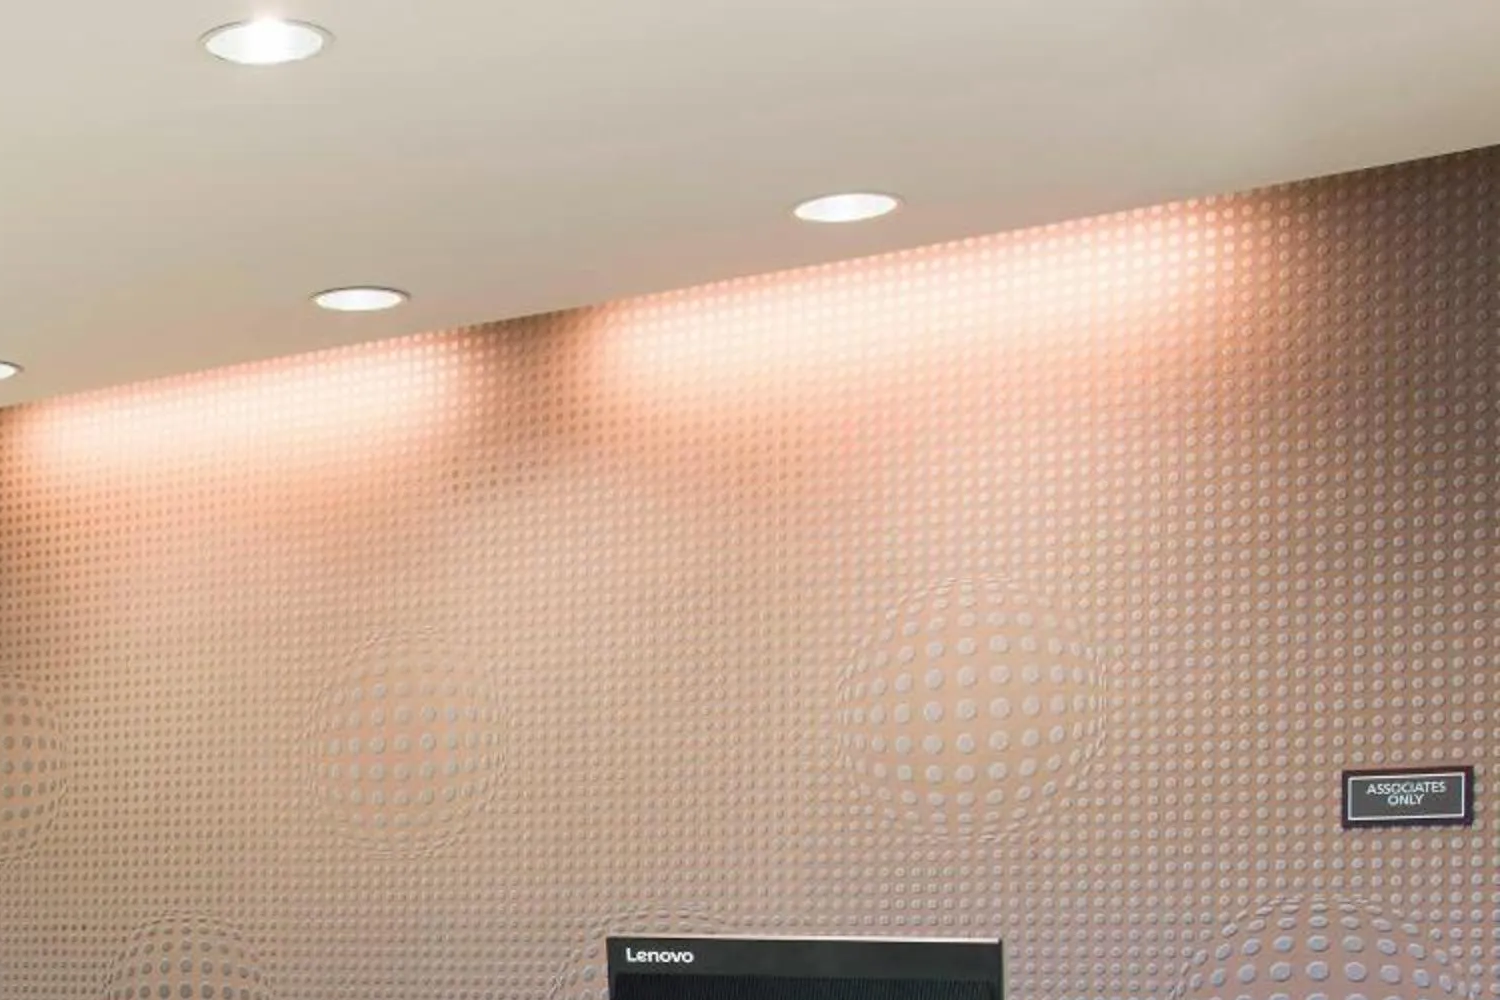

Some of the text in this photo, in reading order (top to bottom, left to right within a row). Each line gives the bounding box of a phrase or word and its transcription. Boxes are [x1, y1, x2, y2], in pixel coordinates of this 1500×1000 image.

[1366, 781, 1447, 795] ASSOCIATES
[1387, 794, 1425, 806] ONLY
[625, 947, 695, 963] Lenovo
